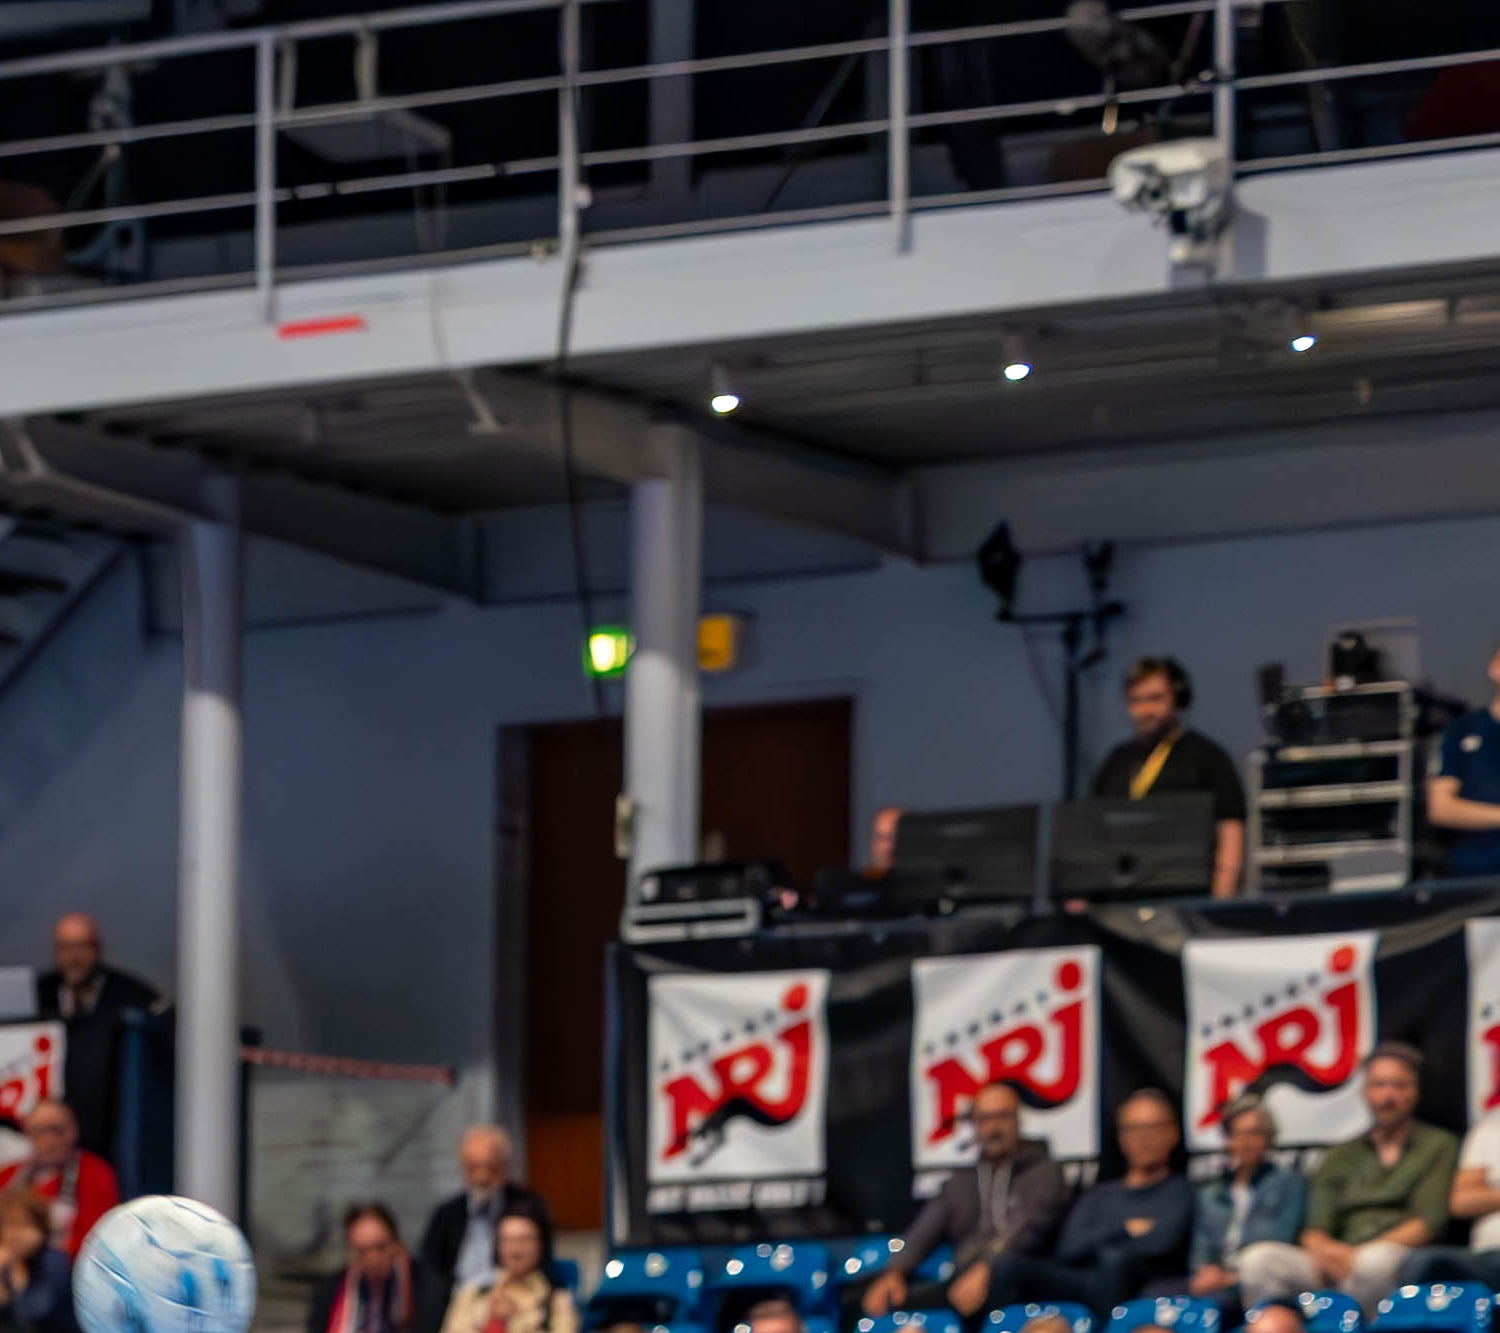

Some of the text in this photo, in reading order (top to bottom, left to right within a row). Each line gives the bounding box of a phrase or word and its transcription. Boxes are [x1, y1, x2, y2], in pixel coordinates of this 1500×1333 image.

[662, 982, 810, 1163] NRJ
[928, 961, 1083, 1144] NRJ
[1198, 945, 1358, 1128] NRJ
